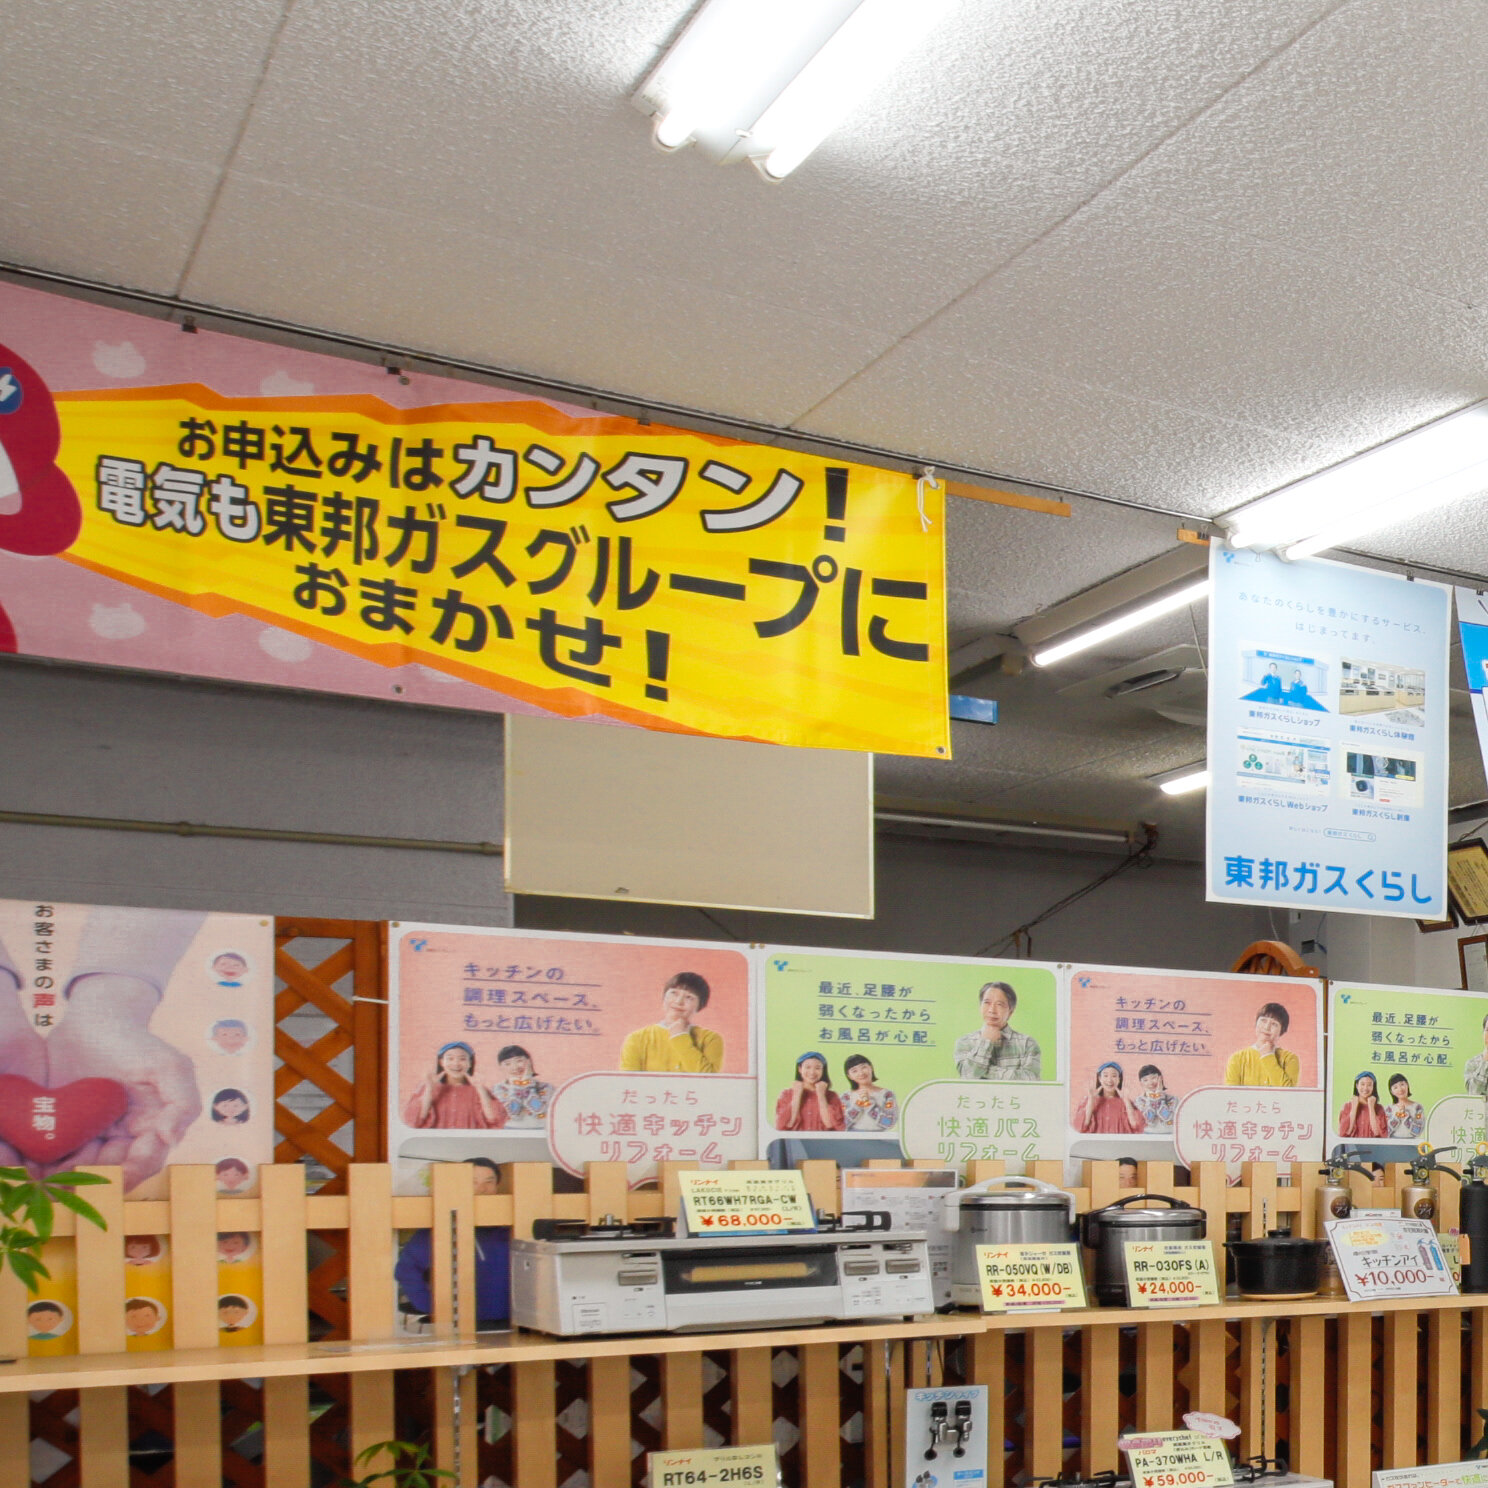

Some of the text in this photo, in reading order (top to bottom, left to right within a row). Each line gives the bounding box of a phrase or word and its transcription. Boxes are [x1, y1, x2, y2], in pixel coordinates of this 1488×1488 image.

[178, 416, 849, 542] お申込みはカンタン!
[95, 455, 930, 662] 電気も東邦ガスグループに
[292, 562, 672, 703] おまかせ!
[1224, 855, 1432, 903] 東邦ガスくらし
[33, 903, 55, 1029] お客さまの声は
[464, 962, 564, 981] キッチンの
[464, 988, 599, 1008] 調理スペース、
[819, 981, 913, 998] 最近、足腰が
[819, 1004, 931, 1021] 弱くなったから
[1115, 997, 1185, 1011] キッチンの
[464, 1014, 600, 1033] もっと広げたい。
[1116, 1017, 1210, 1033] 調理スペース、
[1372, 1011, 1439, 1026] 最近、足腰が
[819, 1027, 935, 1044] お風呂が心配。
[1372, 1031, 1450, 1046] 弱くなったから
[622, 1089, 699, 1106] だったら
[956, 1095, 1020, 1109] だったら
[1226, 1101, 1281, 1114] だったら
[31, 1095, 56, 1144] 宝物。
[574, 1112, 743, 1137] 快適キッチン
[938, 1116, 1040, 1138] 快適バス
[1193, 1120, 1313, 1140] 快適キッチン
[1451, 1126, 1486, 1145] 快適
[600, 1140, 722, 1165] リフォーム
[938, 1142, 1040, 1161] リフォーム
[1212, 1144, 1298, 1162] リフォーム
[693, 1195, 796, 1206] RT66WH7RGA-CW
[701, 1214, 793, 1227] ¥68,000-
[1363, 1254, 1418, 1267] キッチンアイ
[991, 1282, 1071, 1297] ¥34,000-
[1137, 1281, 1202, 1294] ¥24,000-
[663, 1466, 764, 1488] RT64-2H6S
[1143, 1472, 1214, 1488] ¥59,000-
